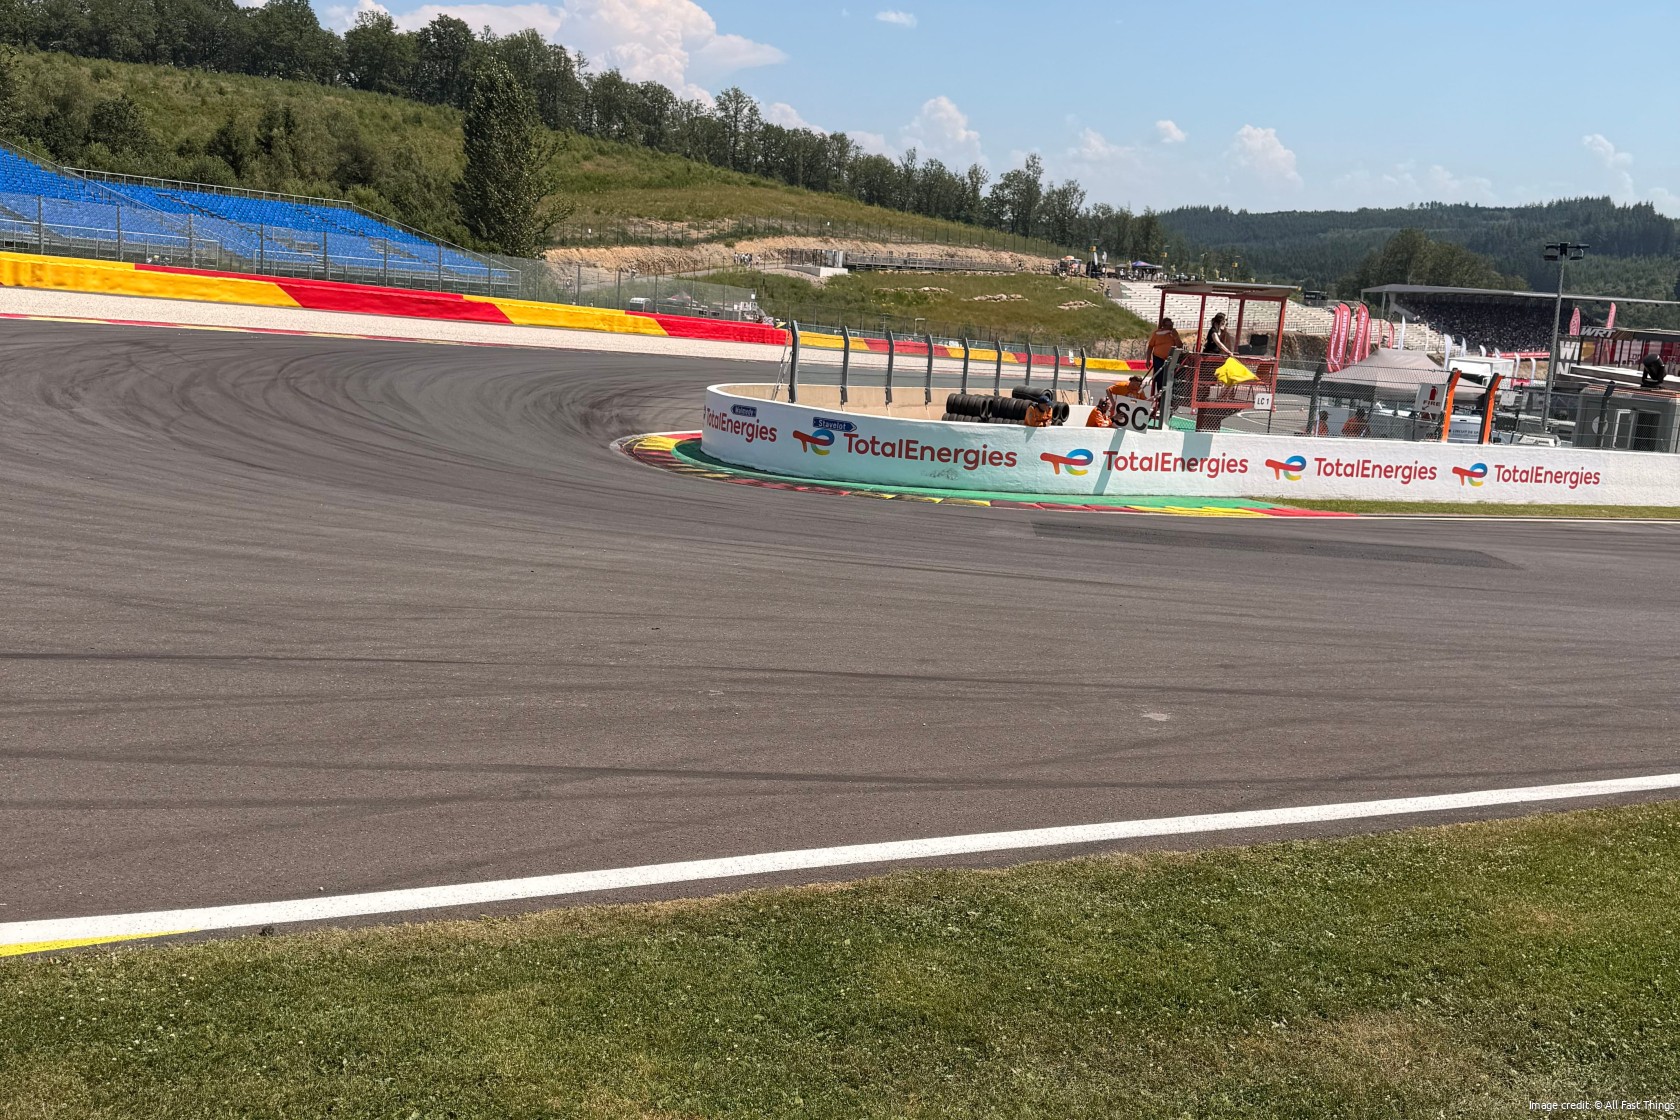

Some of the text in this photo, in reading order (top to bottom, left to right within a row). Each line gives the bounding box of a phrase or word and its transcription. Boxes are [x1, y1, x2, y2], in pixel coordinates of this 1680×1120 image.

[1580, 327, 1616, 338] WRT
[1257, 397, 1265, 405] LC
[706, 407, 778, 443] TotalEnergies
[818, 419, 847, 430] Stavelot
[1114, 402, 1149, 431] SC
[843, 432, 1017, 471] TotalEnergies
[1103, 450, 1249, 479] TotalEnergies
[1314, 457, 1437, 484] TotalEnergies
[1494, 464, 1601, 490] TotalEnergies
